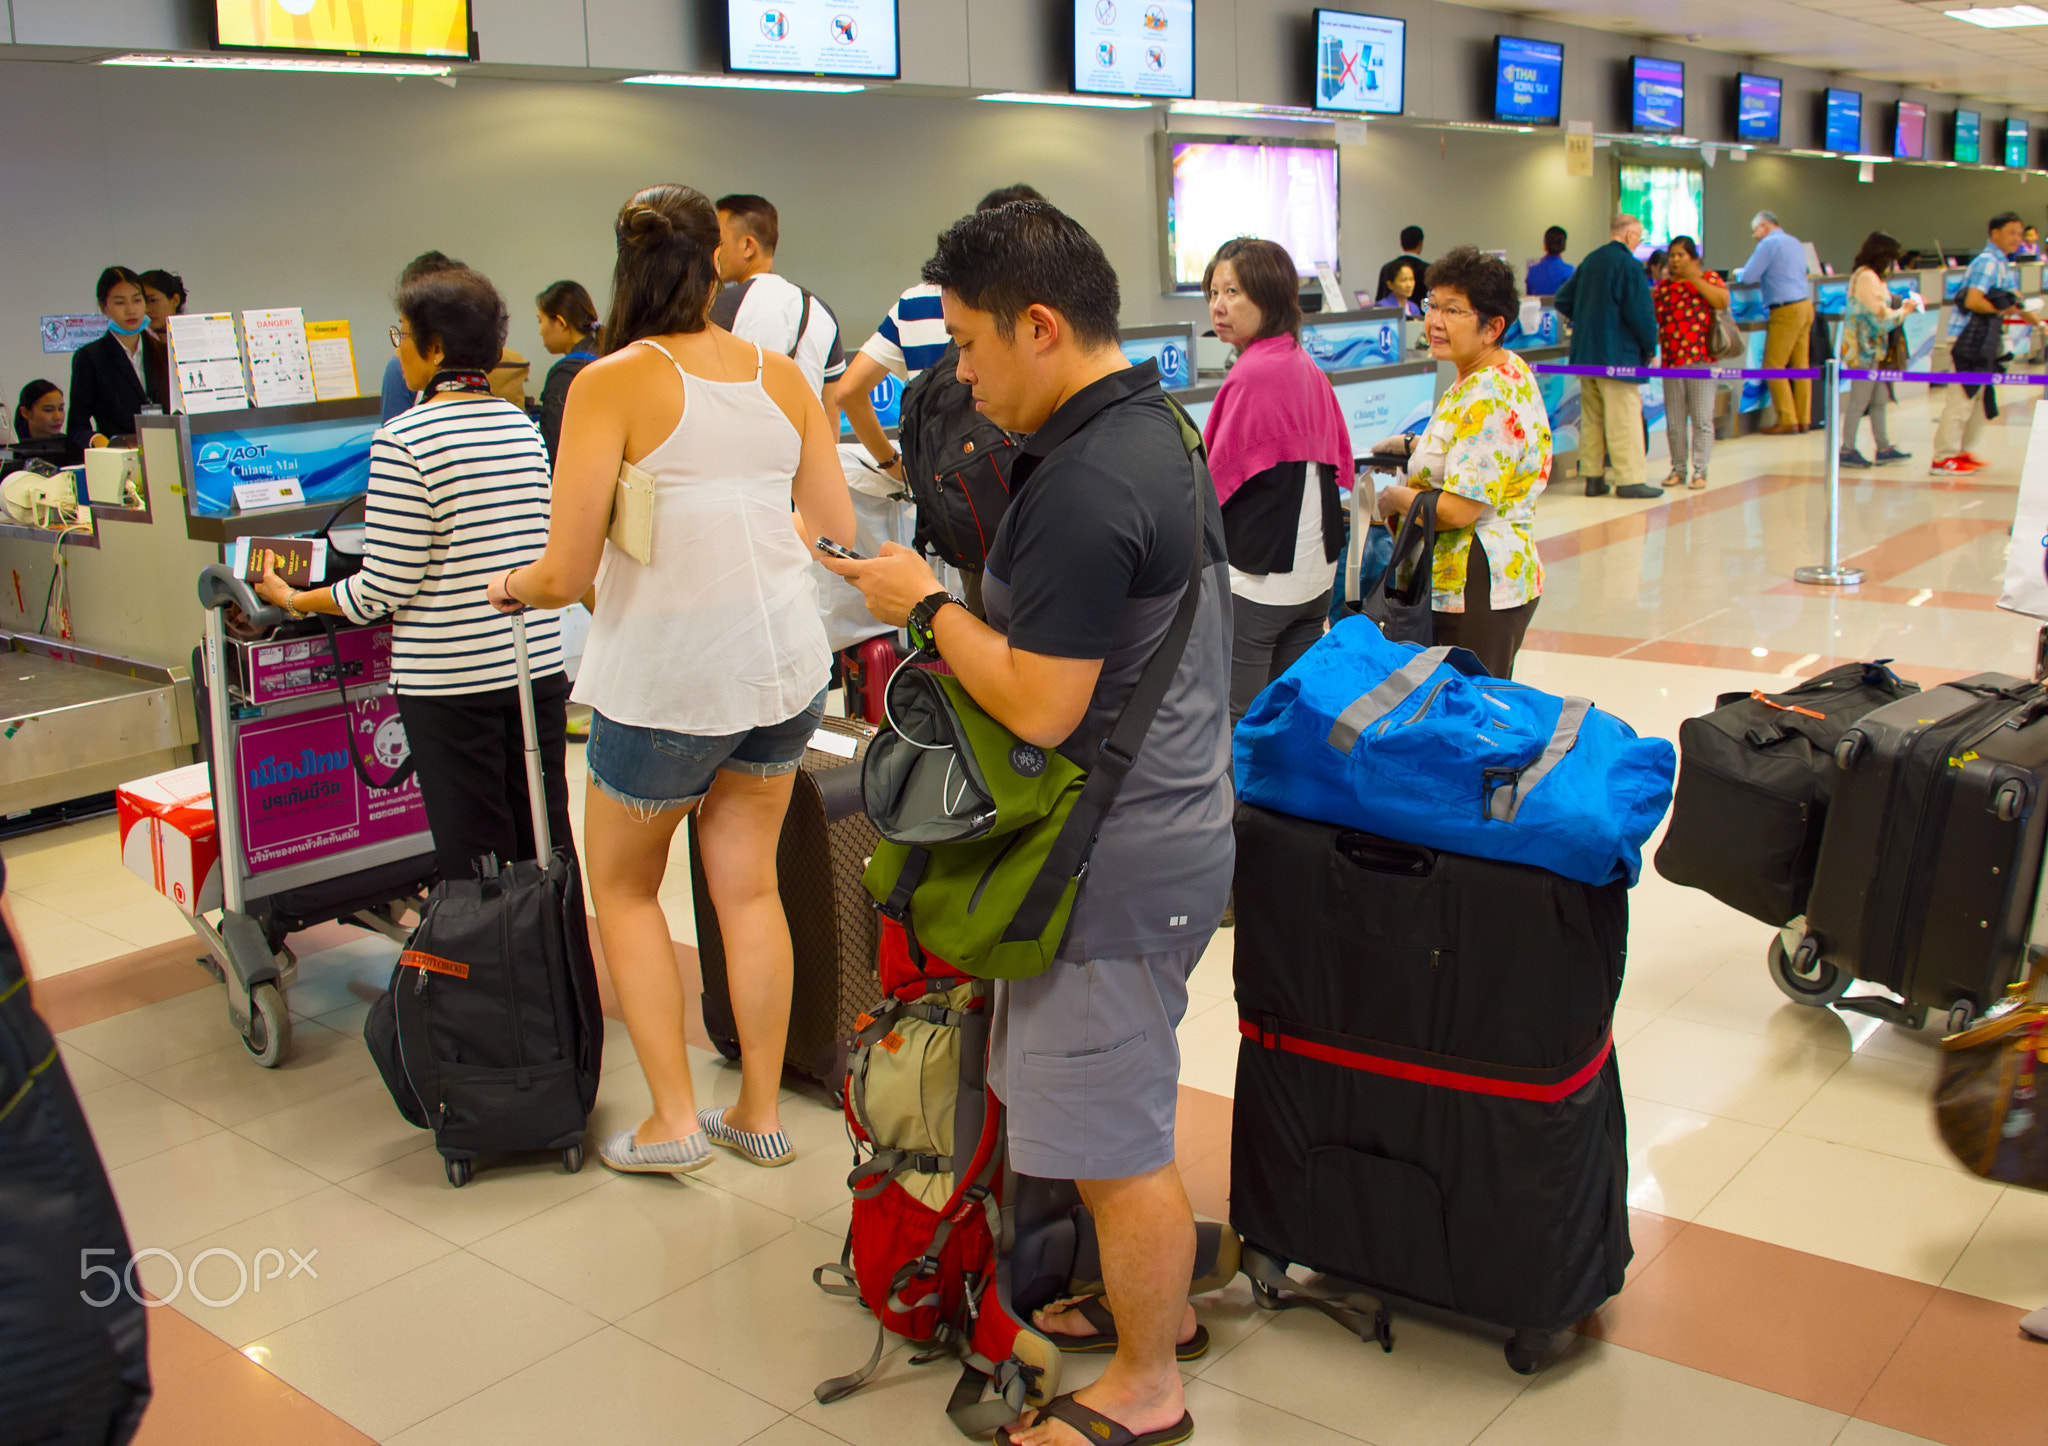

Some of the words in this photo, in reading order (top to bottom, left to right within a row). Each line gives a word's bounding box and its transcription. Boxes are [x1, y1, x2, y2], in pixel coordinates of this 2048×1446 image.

[1515, 67, 1537, 82] THAI
[257, 319, 293, 328] DANGER!
[1380, 330, 1391, 347] 14
[1164, 350, 1178, 370] 12
[873, 380, 888, 402] 11
[231, 444, 269, 462] AOT
[231, 462, 273, 477] Chiang
[276, 458, 299, 471] Mai
[249, 747, 349, 789] เมืองไทย
[262, 779, 341, 811] ประกันชีวิต
